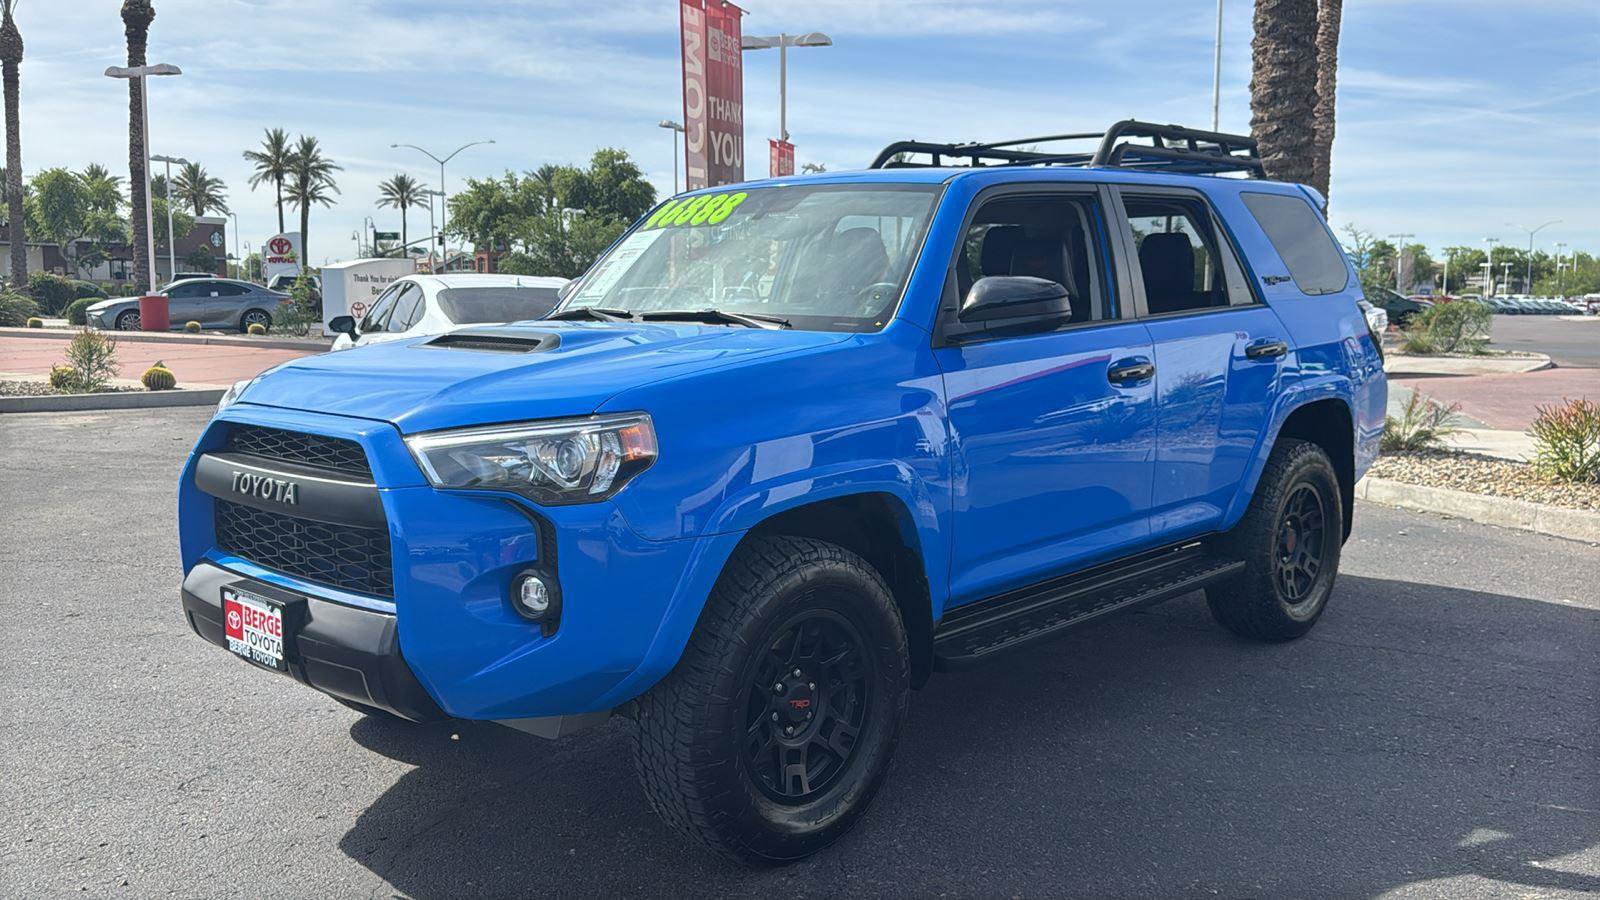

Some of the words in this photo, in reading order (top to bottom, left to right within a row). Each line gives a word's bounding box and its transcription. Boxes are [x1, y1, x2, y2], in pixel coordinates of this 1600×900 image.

[708, 96, 742, 126] THANK
[710, 130, 742, 169] YOU
[353, 273, 370, 283] Thank
[370, 275, 379, 283] You
[232, 471, 296, 505] TOYOTA
[244, 606, 283, 638] BERGE
[229, 640, 251, 658] BERGE
[251, 649, 278, 669] TOYOTA
[244, 629, 284, 656] TOYOTA
[788, 699, 810, 709] TRD
